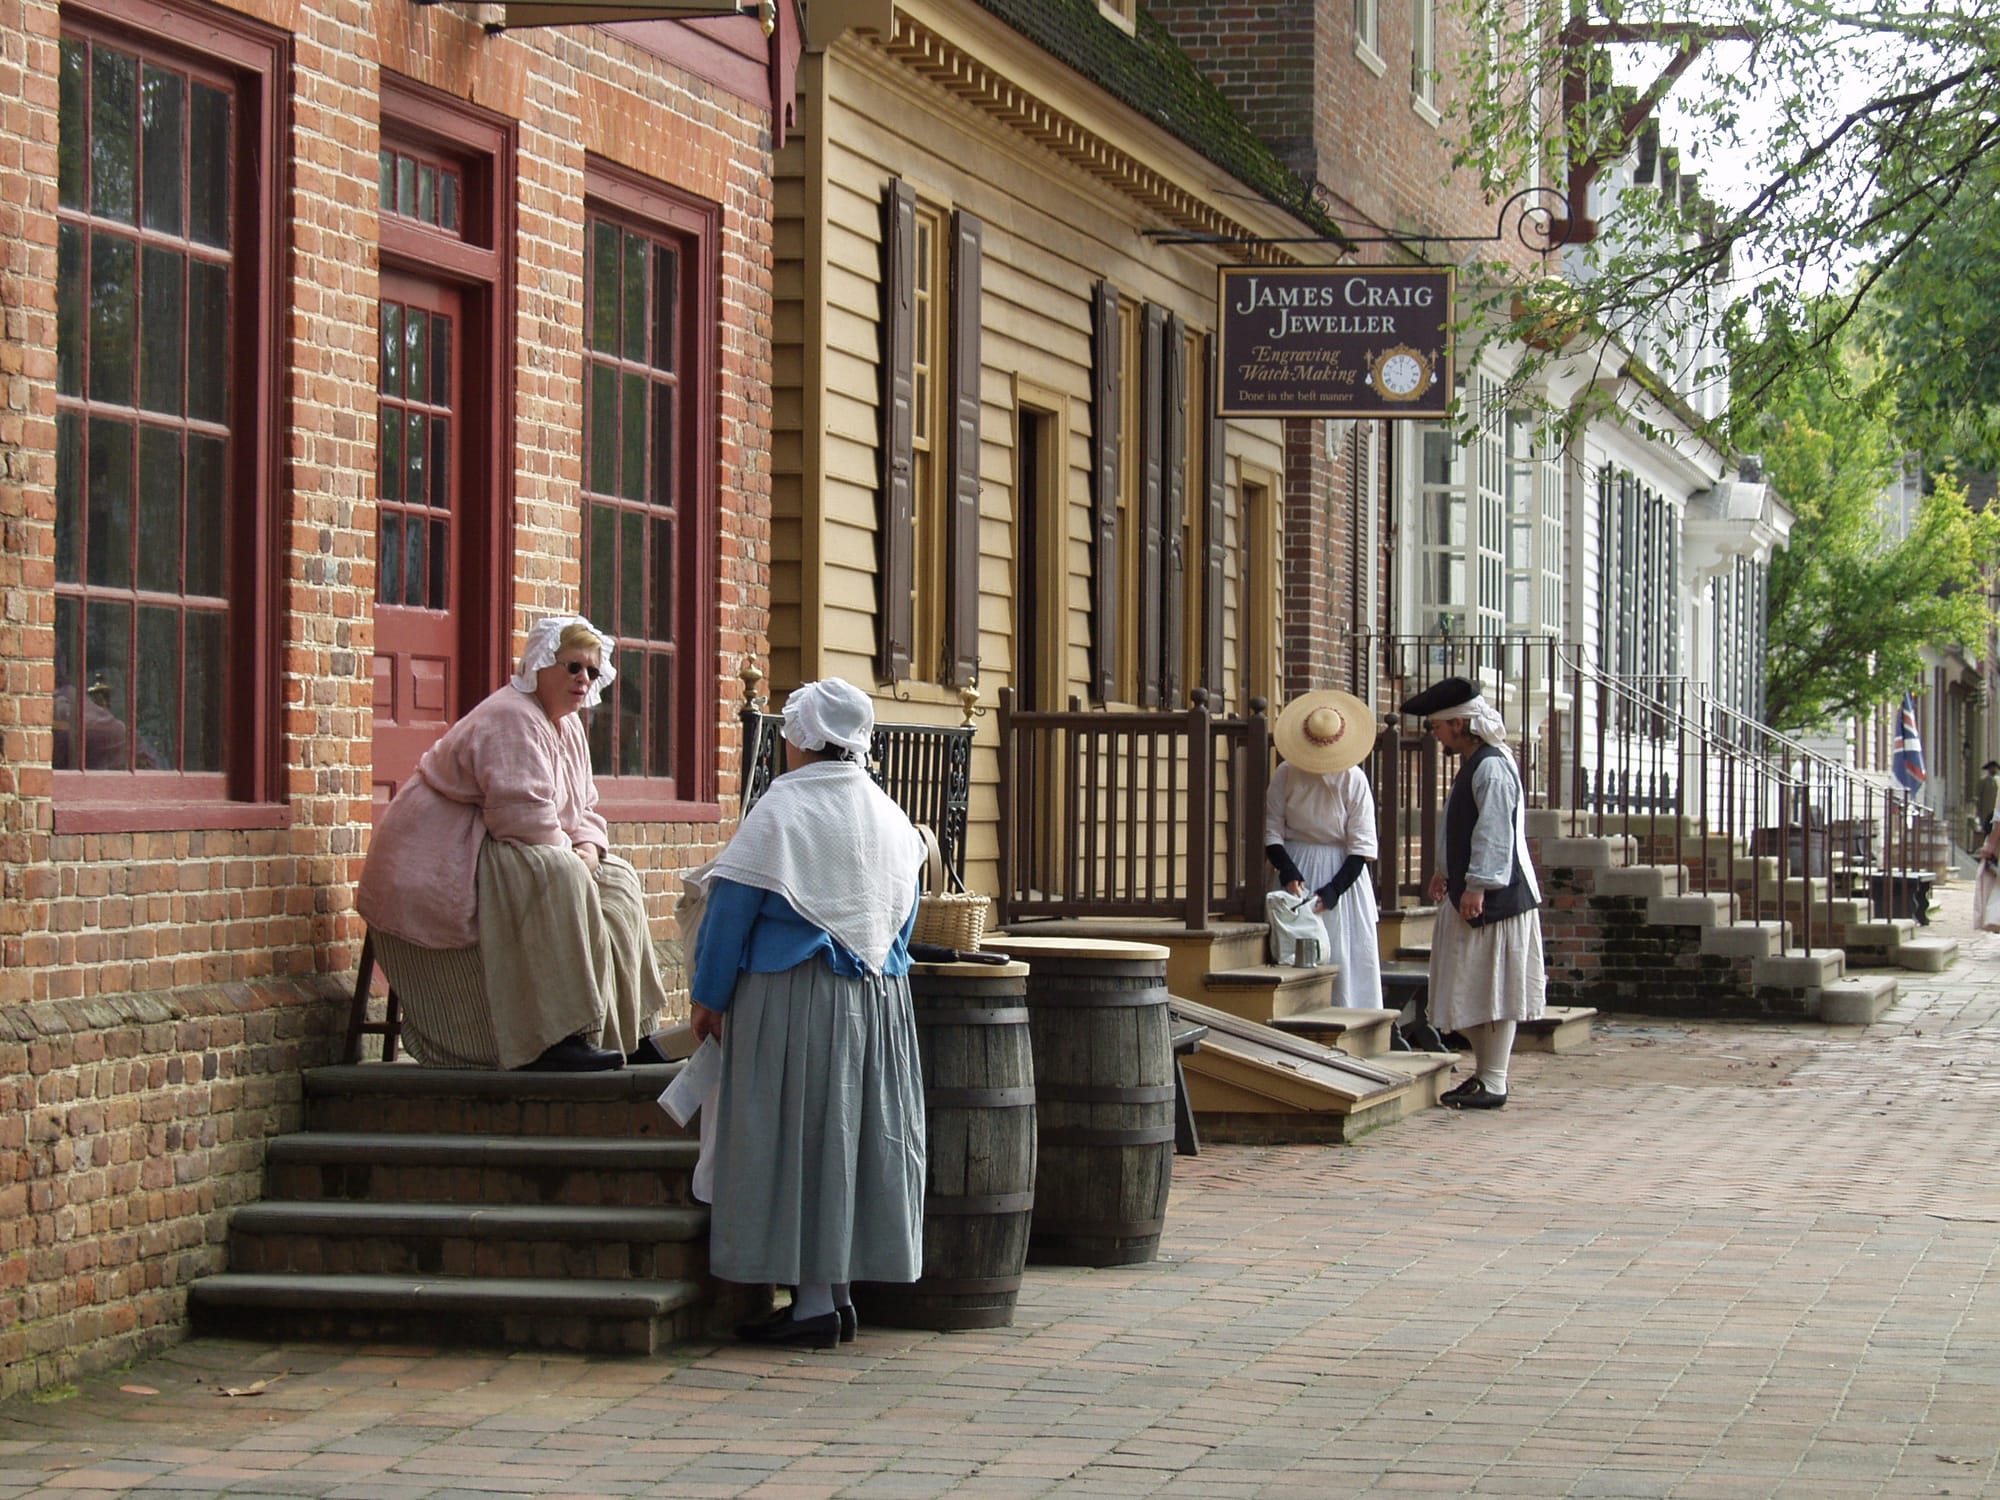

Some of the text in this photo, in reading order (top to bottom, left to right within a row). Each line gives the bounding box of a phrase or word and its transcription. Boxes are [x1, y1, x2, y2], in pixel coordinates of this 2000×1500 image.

[1236, 277, 1434, 315] JAMES CRAIG
[1269, 308, 1396, 339] JEWELLER
[1251, 345, 1341, 365] Engraving
[1239, 390, 1264, 401] Done
[1267, 391, 1277, 401] in
[1280, 391, 1294, 401] the
[1320, 393, 1354, 401] manner
